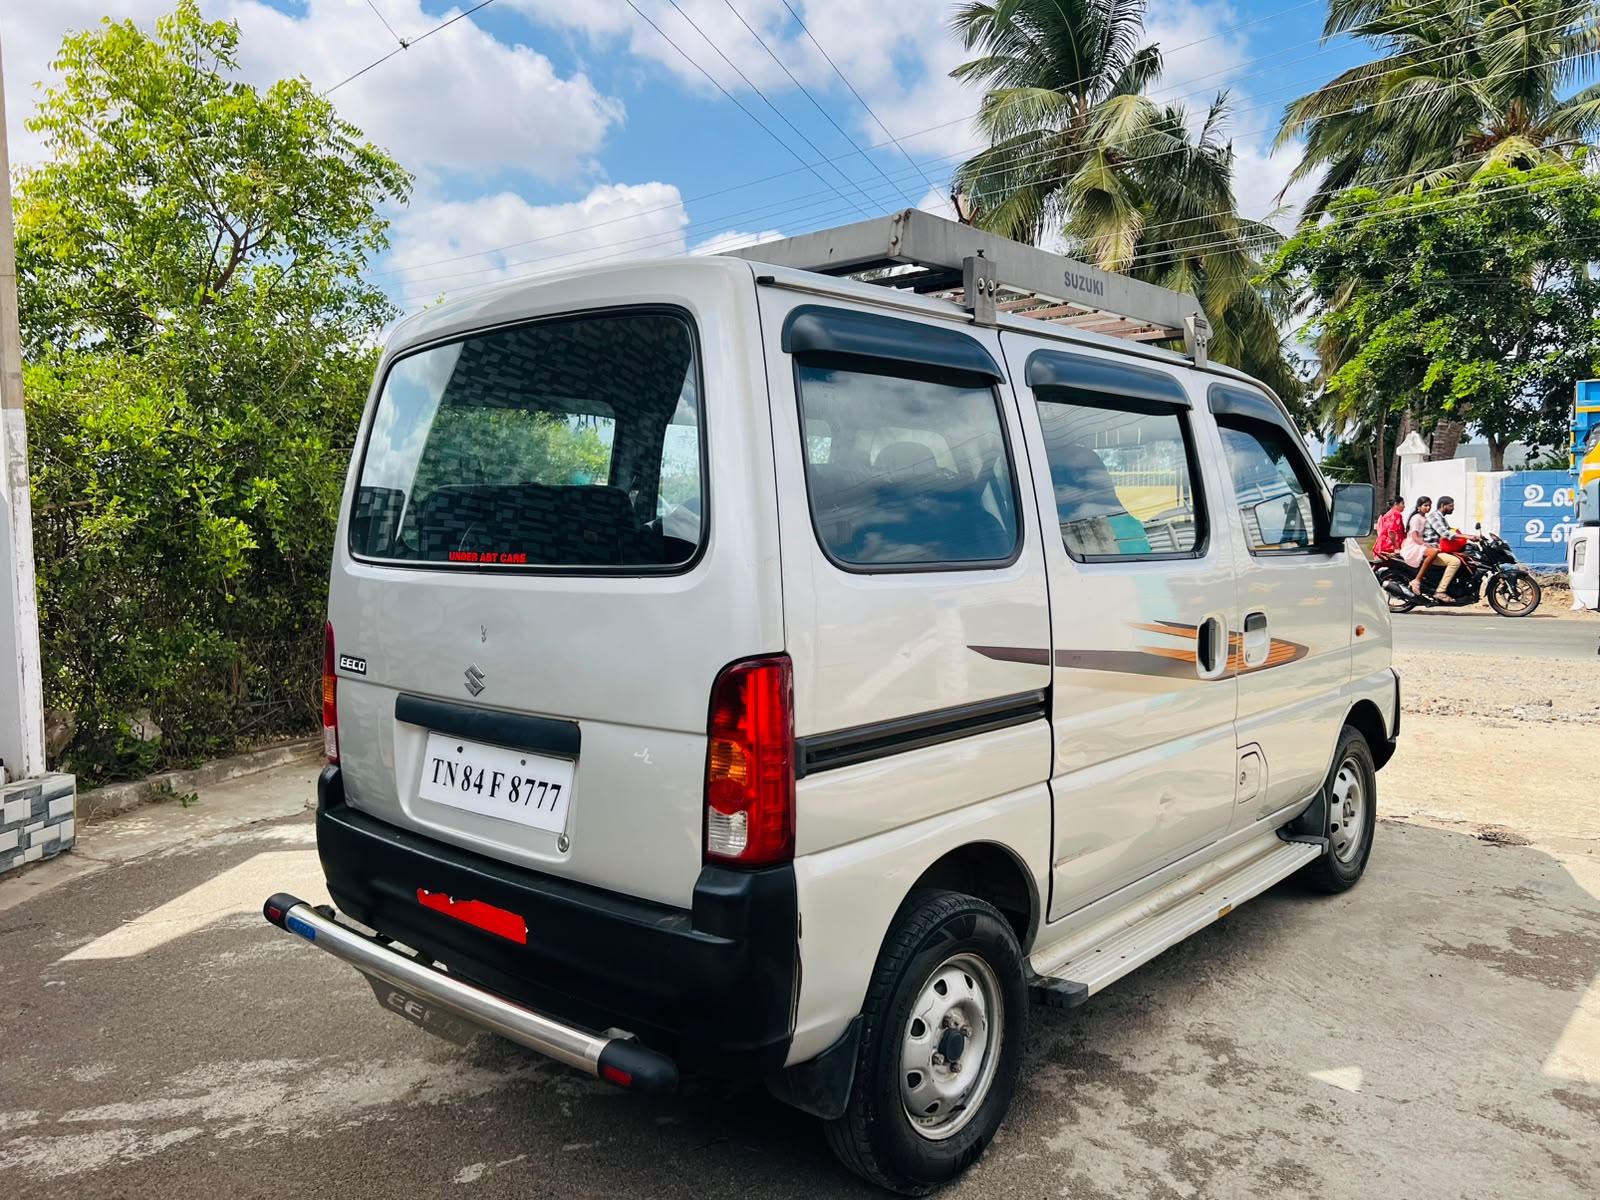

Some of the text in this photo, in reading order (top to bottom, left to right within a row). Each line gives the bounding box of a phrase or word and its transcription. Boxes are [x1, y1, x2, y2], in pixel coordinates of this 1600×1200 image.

[1064, 271, 1104, 296] SUZUKI
[449, 551, 478, 562] UNDER
[500, 553, 527, 564] CARE
[340, 657, 366, 672] EECO
[508, 775, 562, 812] 8777
